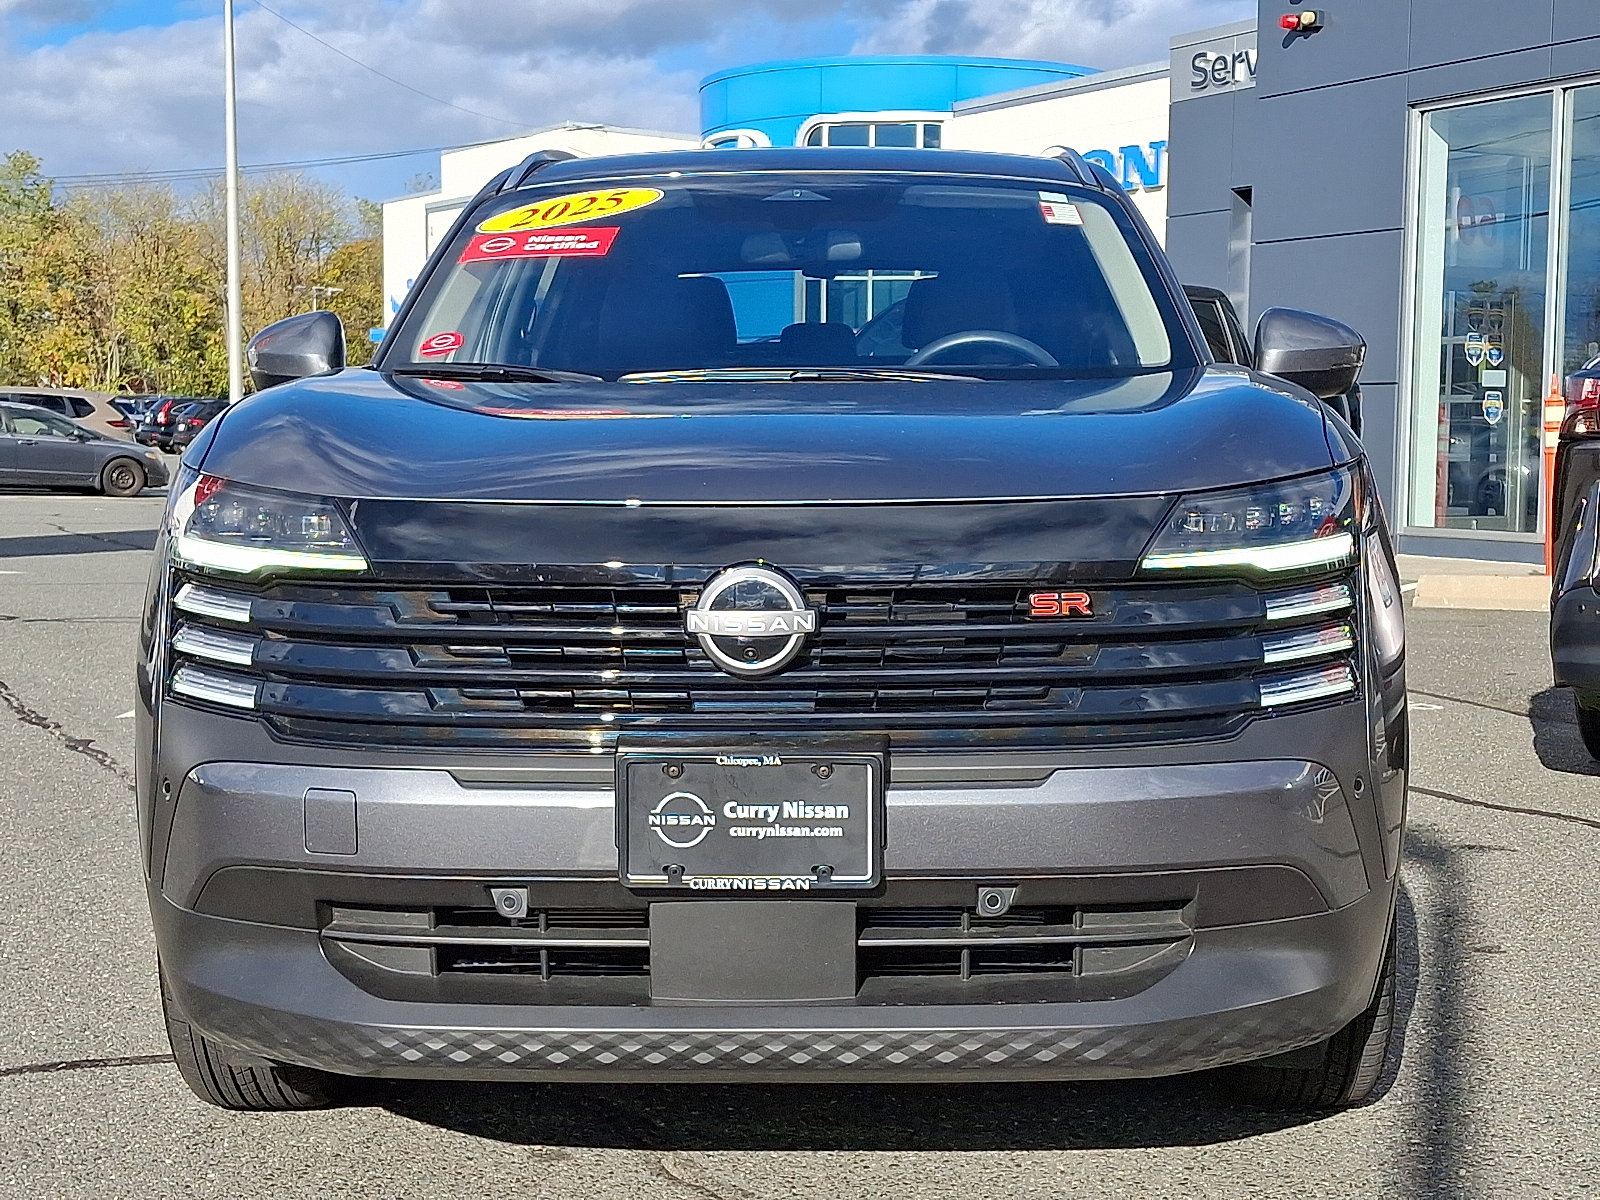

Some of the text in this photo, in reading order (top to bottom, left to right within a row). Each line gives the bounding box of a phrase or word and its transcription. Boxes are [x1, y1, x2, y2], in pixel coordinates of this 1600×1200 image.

[509, 190, 630, 229] 2025
[523, 240, 600, 251] Certified
[528, 234, 587, 243] Nissan
[1029, 591, 1093, 616] SR
[689, 613, 813, 633] NISSAN
[763, 756, 782, 766] MA
[723, 801, 849, 822] Curry Nissan
[648, 814, 716, 825] NISSAN
[729, 824, 843, 839] currynissan.com
